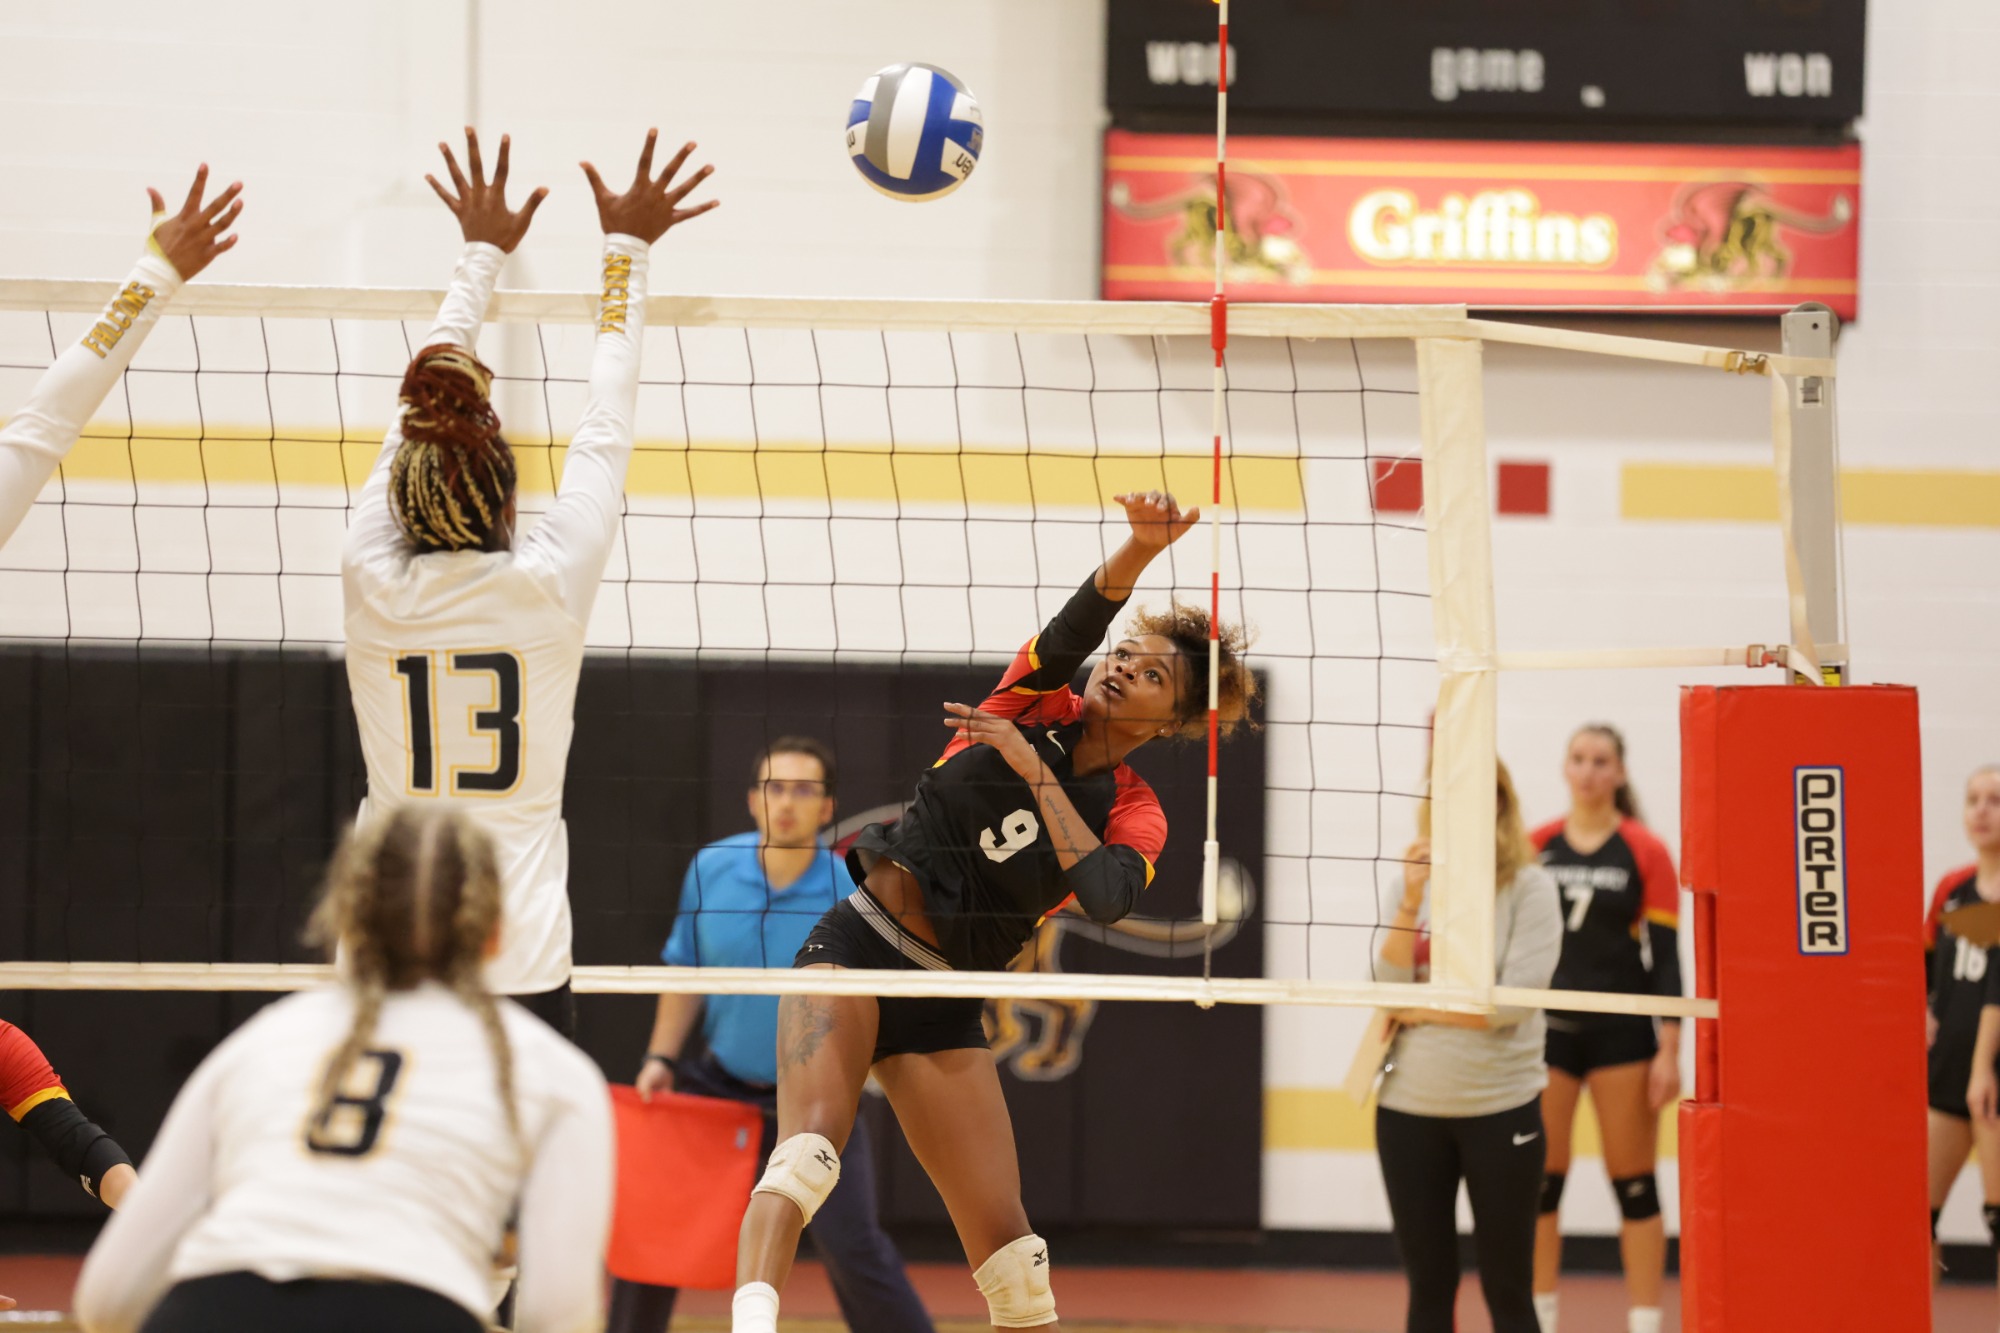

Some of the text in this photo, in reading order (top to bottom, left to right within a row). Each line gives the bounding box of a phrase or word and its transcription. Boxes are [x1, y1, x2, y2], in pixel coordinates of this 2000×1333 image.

[1431, 47, 1544, 101] game
[1745, 53, 1832, 97] won
[1347, 187, 1618, 271] Griffins
[81, 281, 155, 359] FALCONS
[600, 254, 632, 334] FALCONS
[389, 647, 527, 798] 13
[979, 808, 1039, 864] 9
[1564, 885, 1594, 932] 7
[305, 1047, 404, 1156] 8
